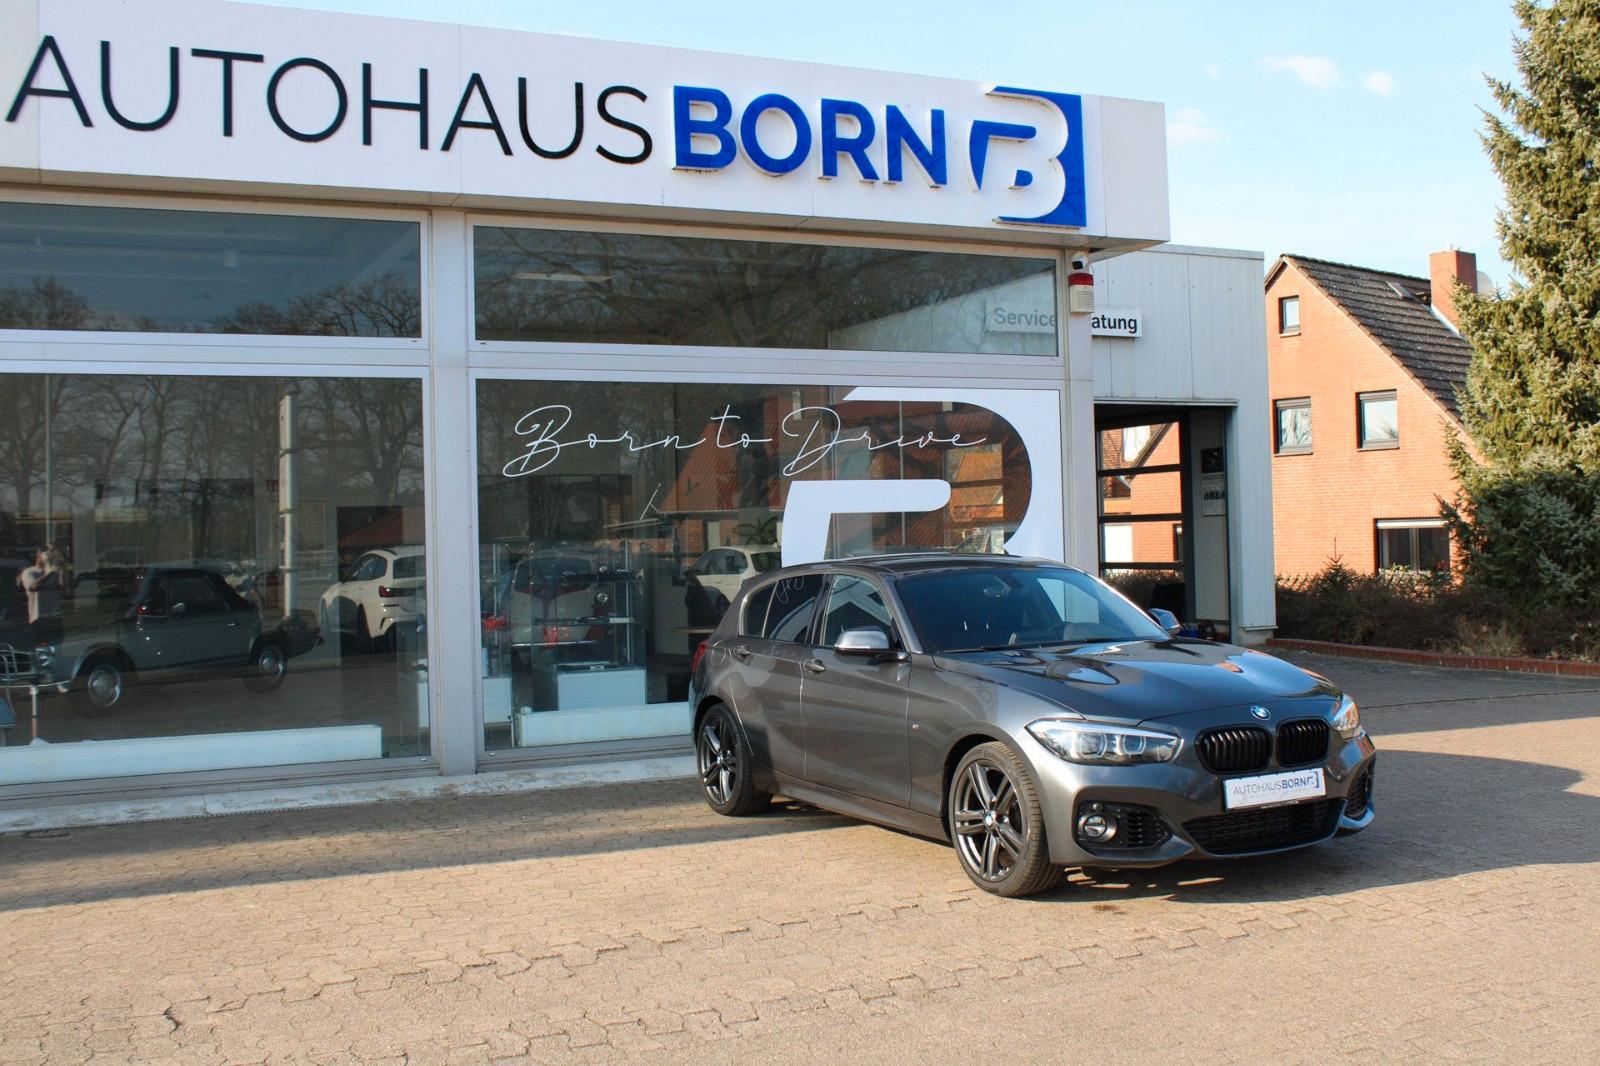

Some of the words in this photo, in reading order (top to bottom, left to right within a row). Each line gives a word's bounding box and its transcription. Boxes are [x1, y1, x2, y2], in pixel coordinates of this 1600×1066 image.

[1091, 313, 1138, 334] atung
[502, 404, 707, 478] Born
[710, 404, 773, 449] to
[781, 406, 987, 477] Drive
